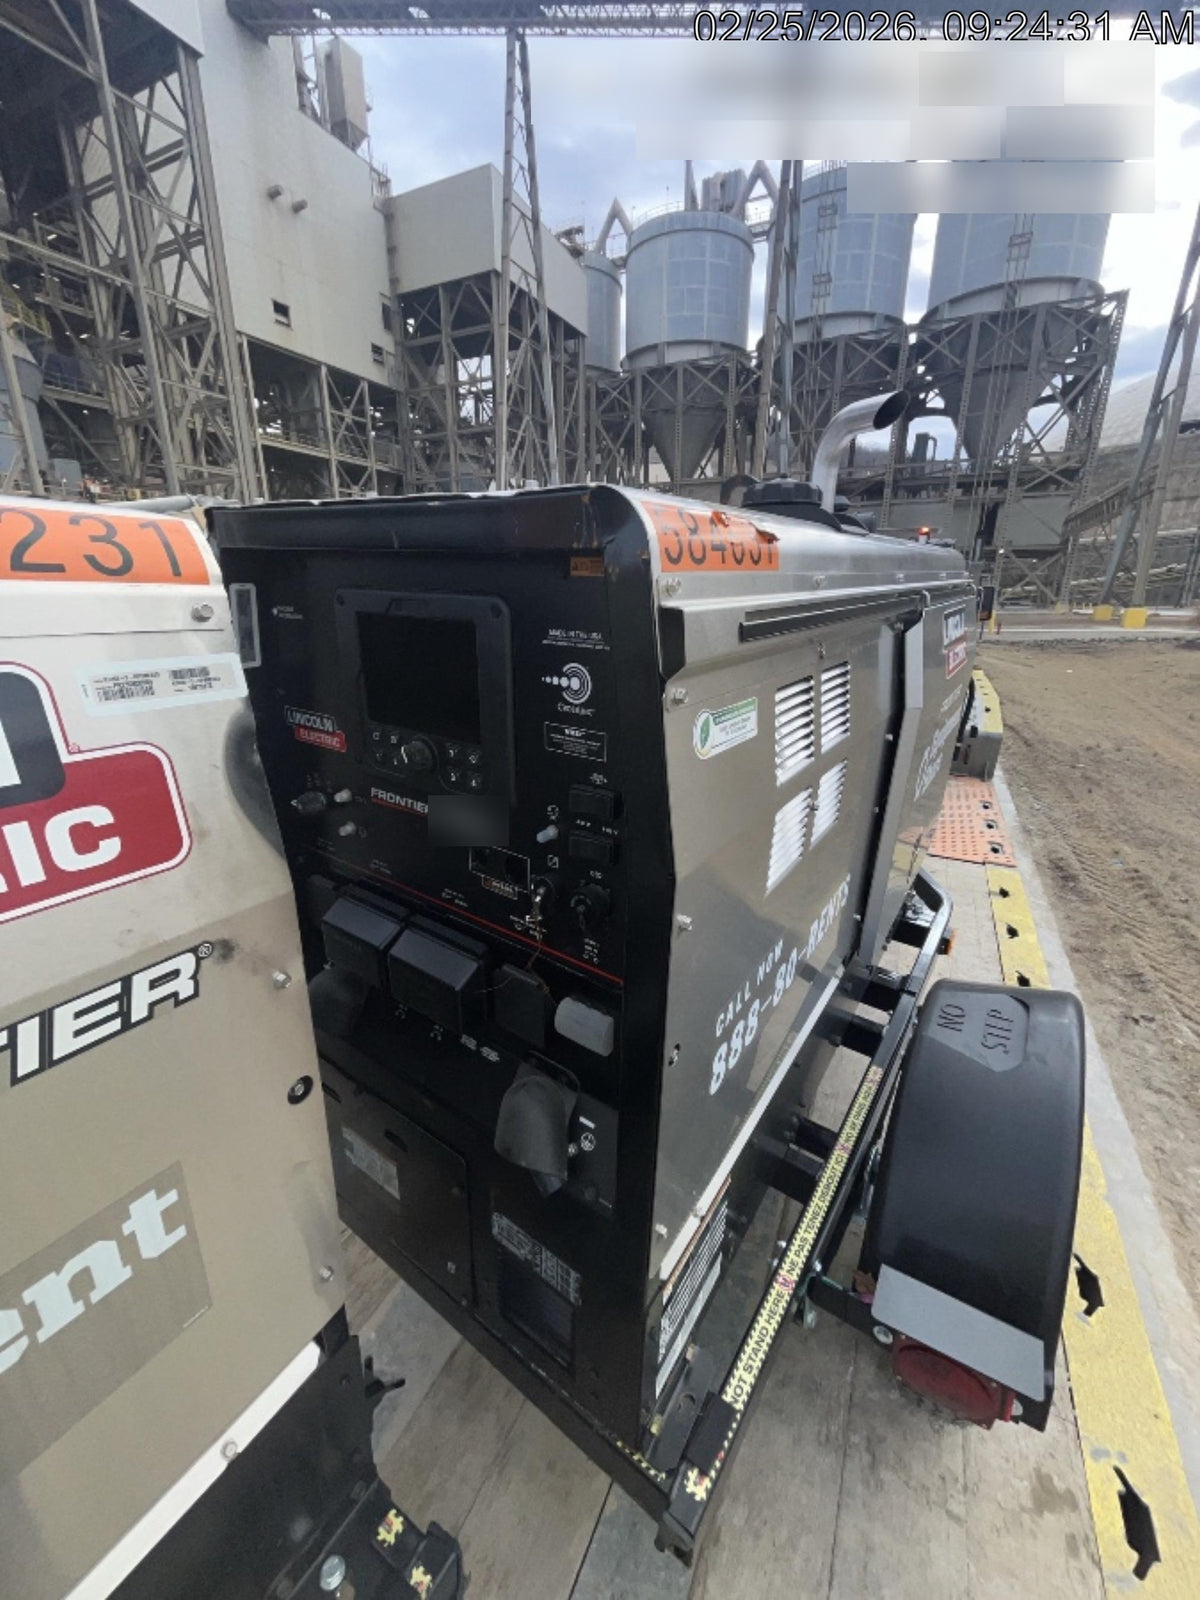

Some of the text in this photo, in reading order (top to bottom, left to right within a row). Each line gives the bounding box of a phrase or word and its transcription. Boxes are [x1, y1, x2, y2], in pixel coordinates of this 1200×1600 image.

[287, 710, 334, 732] LINCOLN
[299, 728, 342, 748] ELECTRIC
[716, 938, 783, 1038] CALL NOW
[937, 1003, 966, 1032] NO
[742, 1325, 769, 1375] STAND
[764, 1289, 785, 1326] HERE
